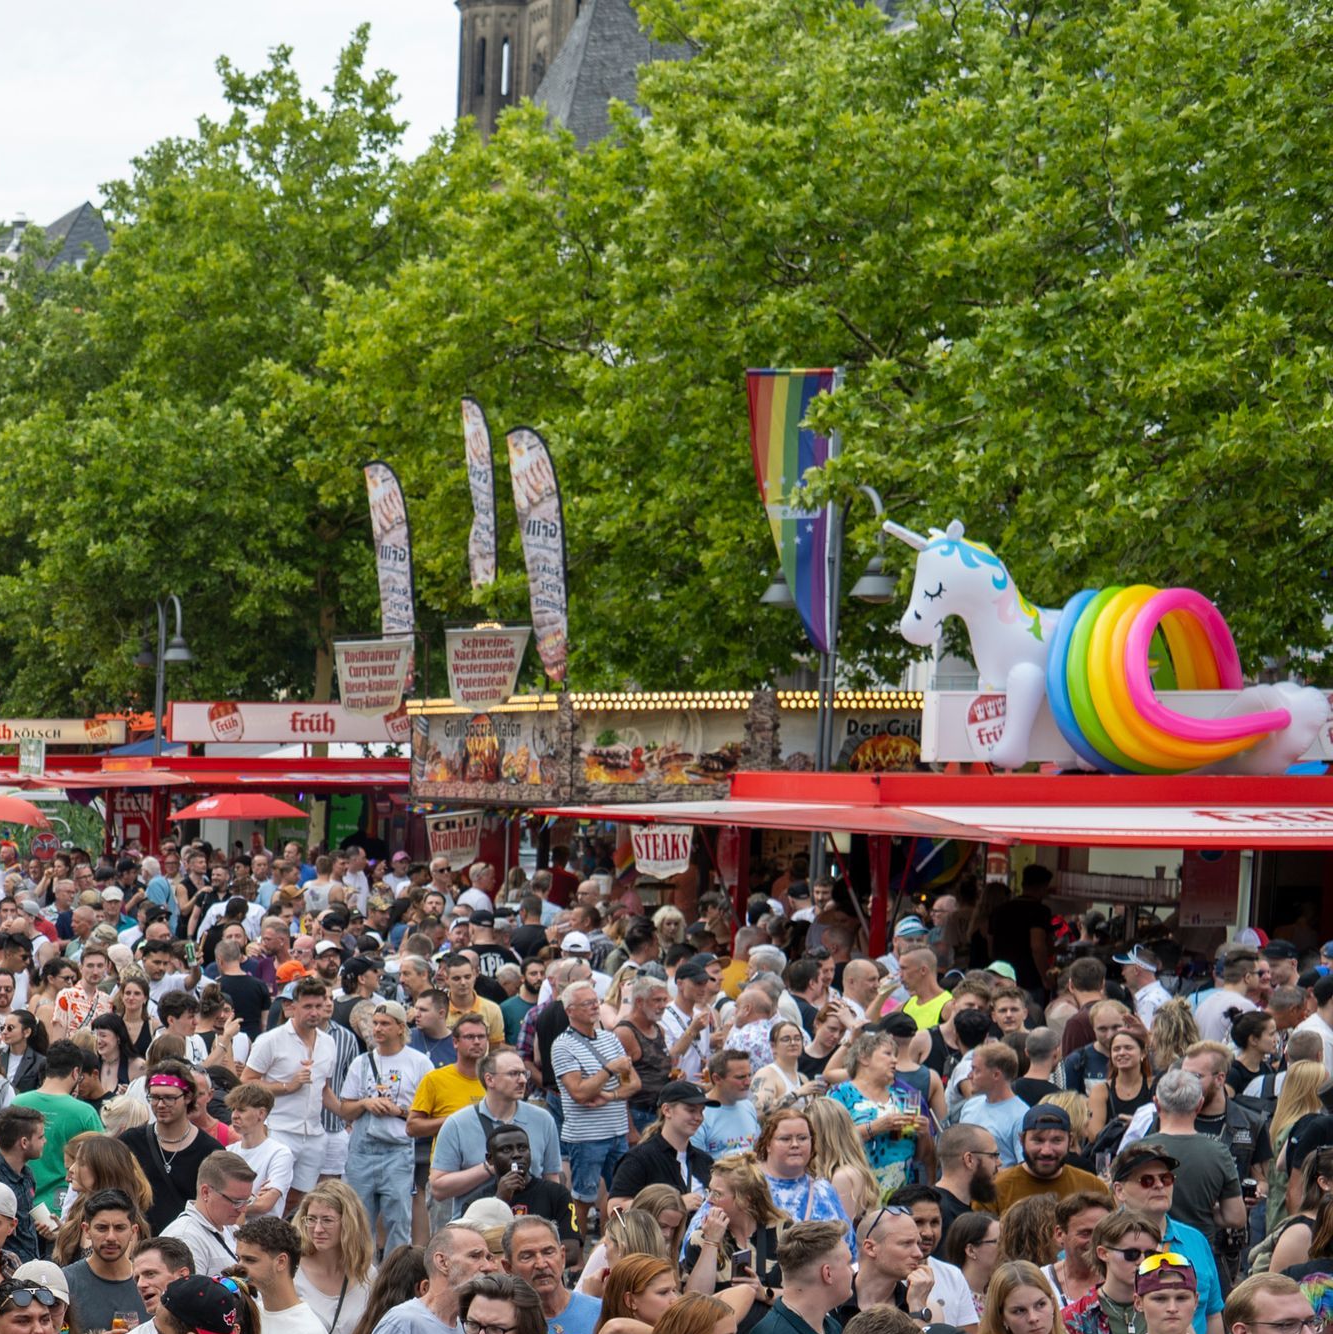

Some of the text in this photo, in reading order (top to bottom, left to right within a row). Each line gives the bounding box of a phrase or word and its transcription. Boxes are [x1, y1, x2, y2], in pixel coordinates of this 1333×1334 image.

[13, 728, 62, 740] KÖLSCH
[846, 718, 922, 738] Der Gril
[431, 829, 478, 853] Bratwurst
[634, 832, 690, 862] STEAKS
